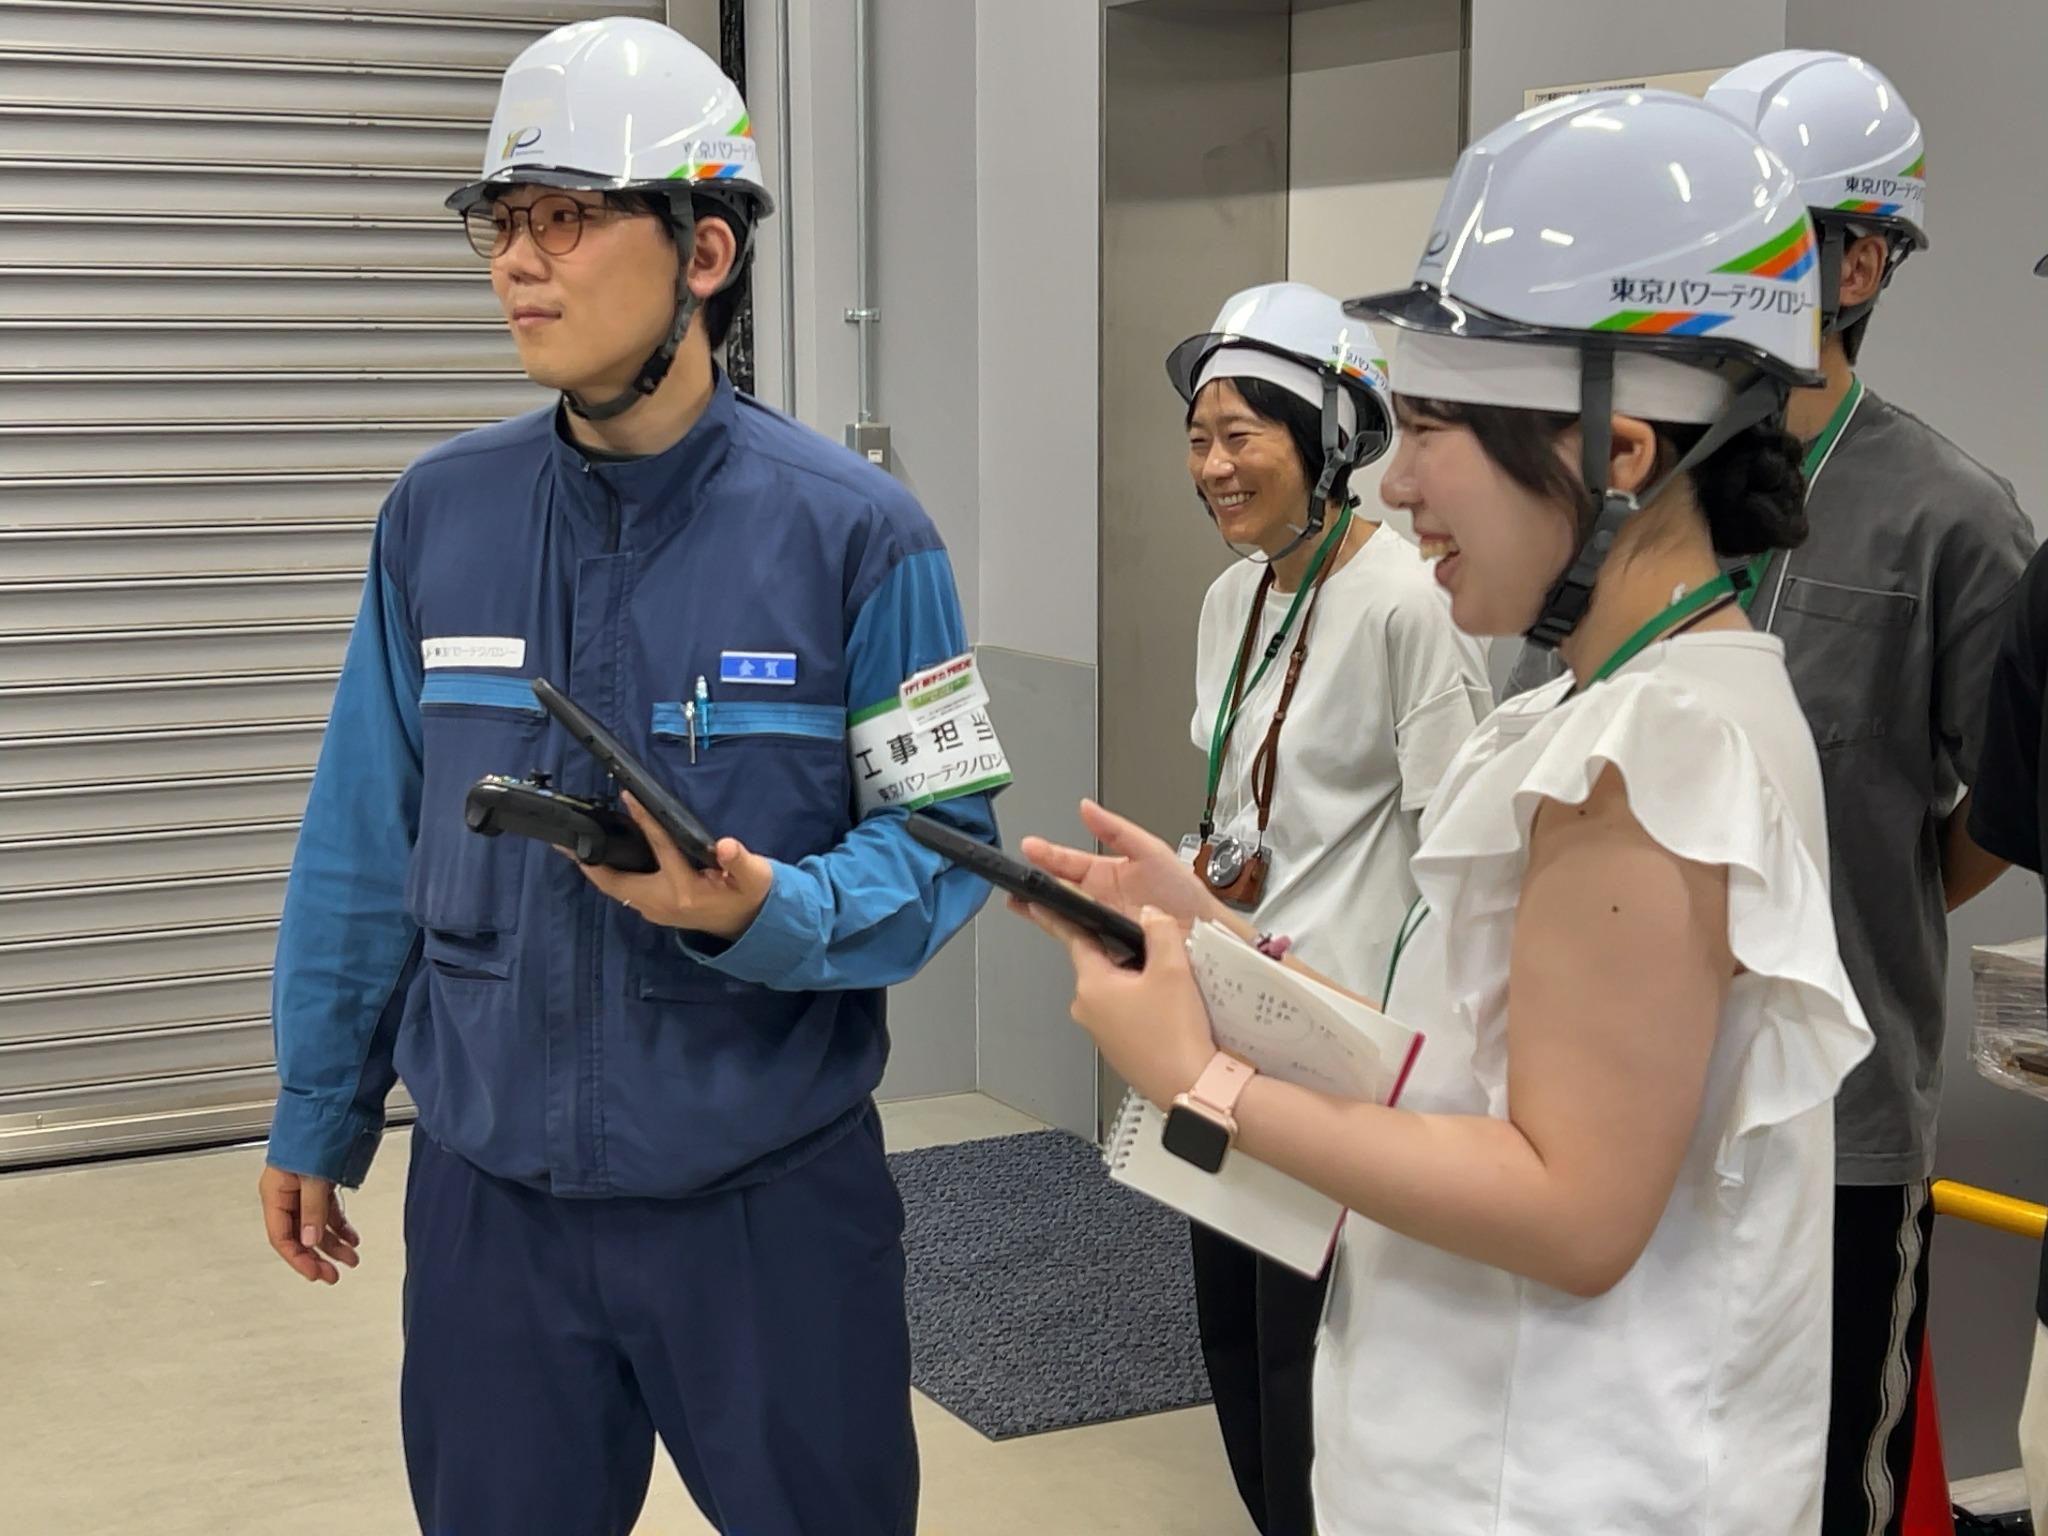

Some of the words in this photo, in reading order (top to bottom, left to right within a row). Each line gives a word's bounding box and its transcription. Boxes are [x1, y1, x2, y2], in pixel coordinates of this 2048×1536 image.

[1609, 277, 1815, 315] 東京パワーテクノロジー
[856, 712, 994, 780] 工事担当
